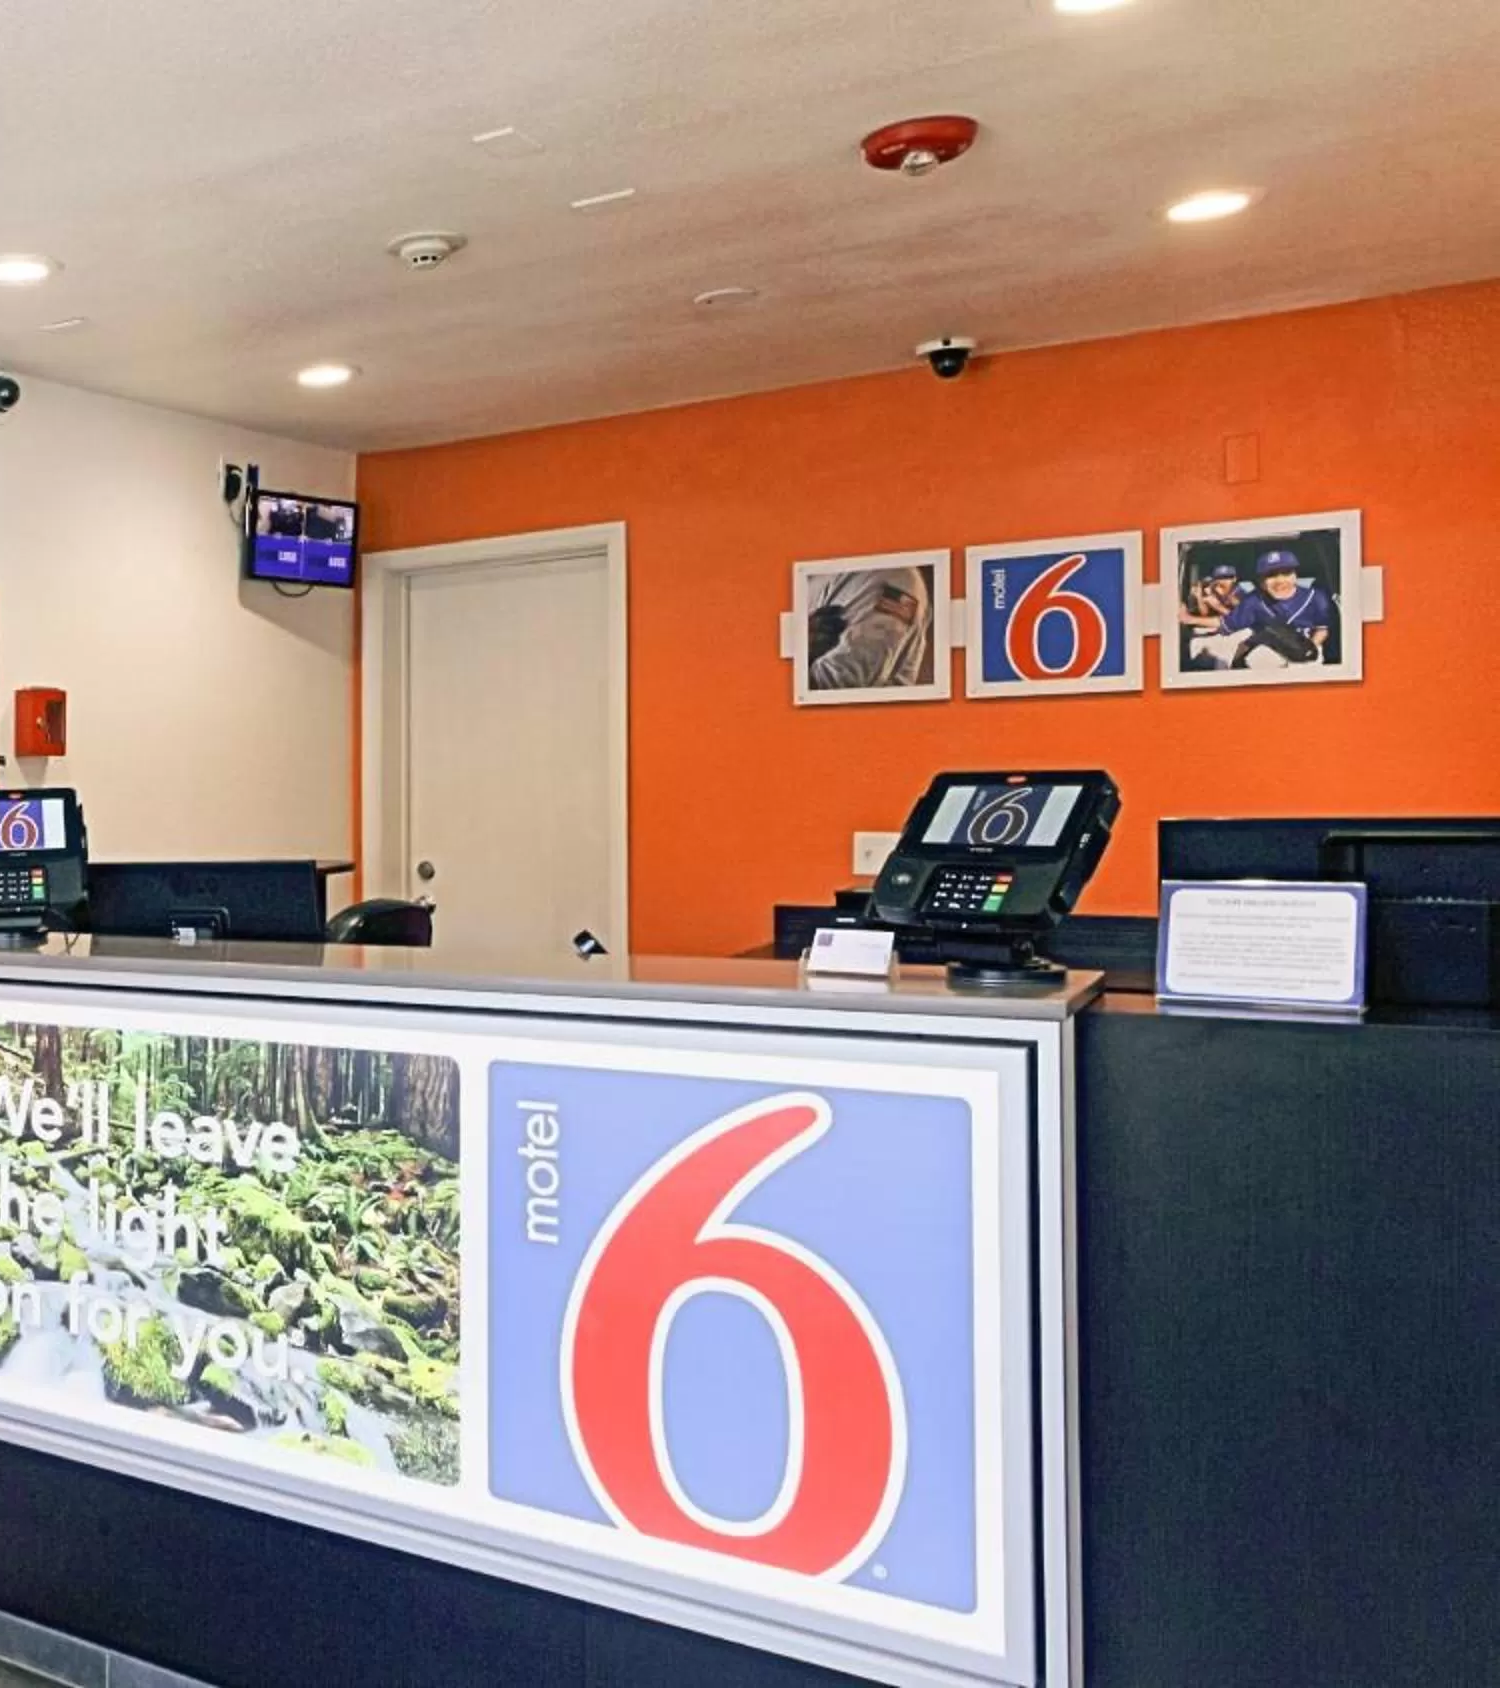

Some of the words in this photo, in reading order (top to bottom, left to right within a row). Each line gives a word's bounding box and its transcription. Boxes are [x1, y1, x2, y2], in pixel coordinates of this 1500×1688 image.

[991, 569, 1007, 610] motel
[1005, 554, 1108, 682] 6
[967, 787, 1034, 845] 6
[135, 1071, 299, 1172] leave
[516, 1100, 561, 1245] motel
[88, 1176, 227, 1269] light
[68, 1271, 151, 1348] for
[560, 1091, 908, 1586] 6
